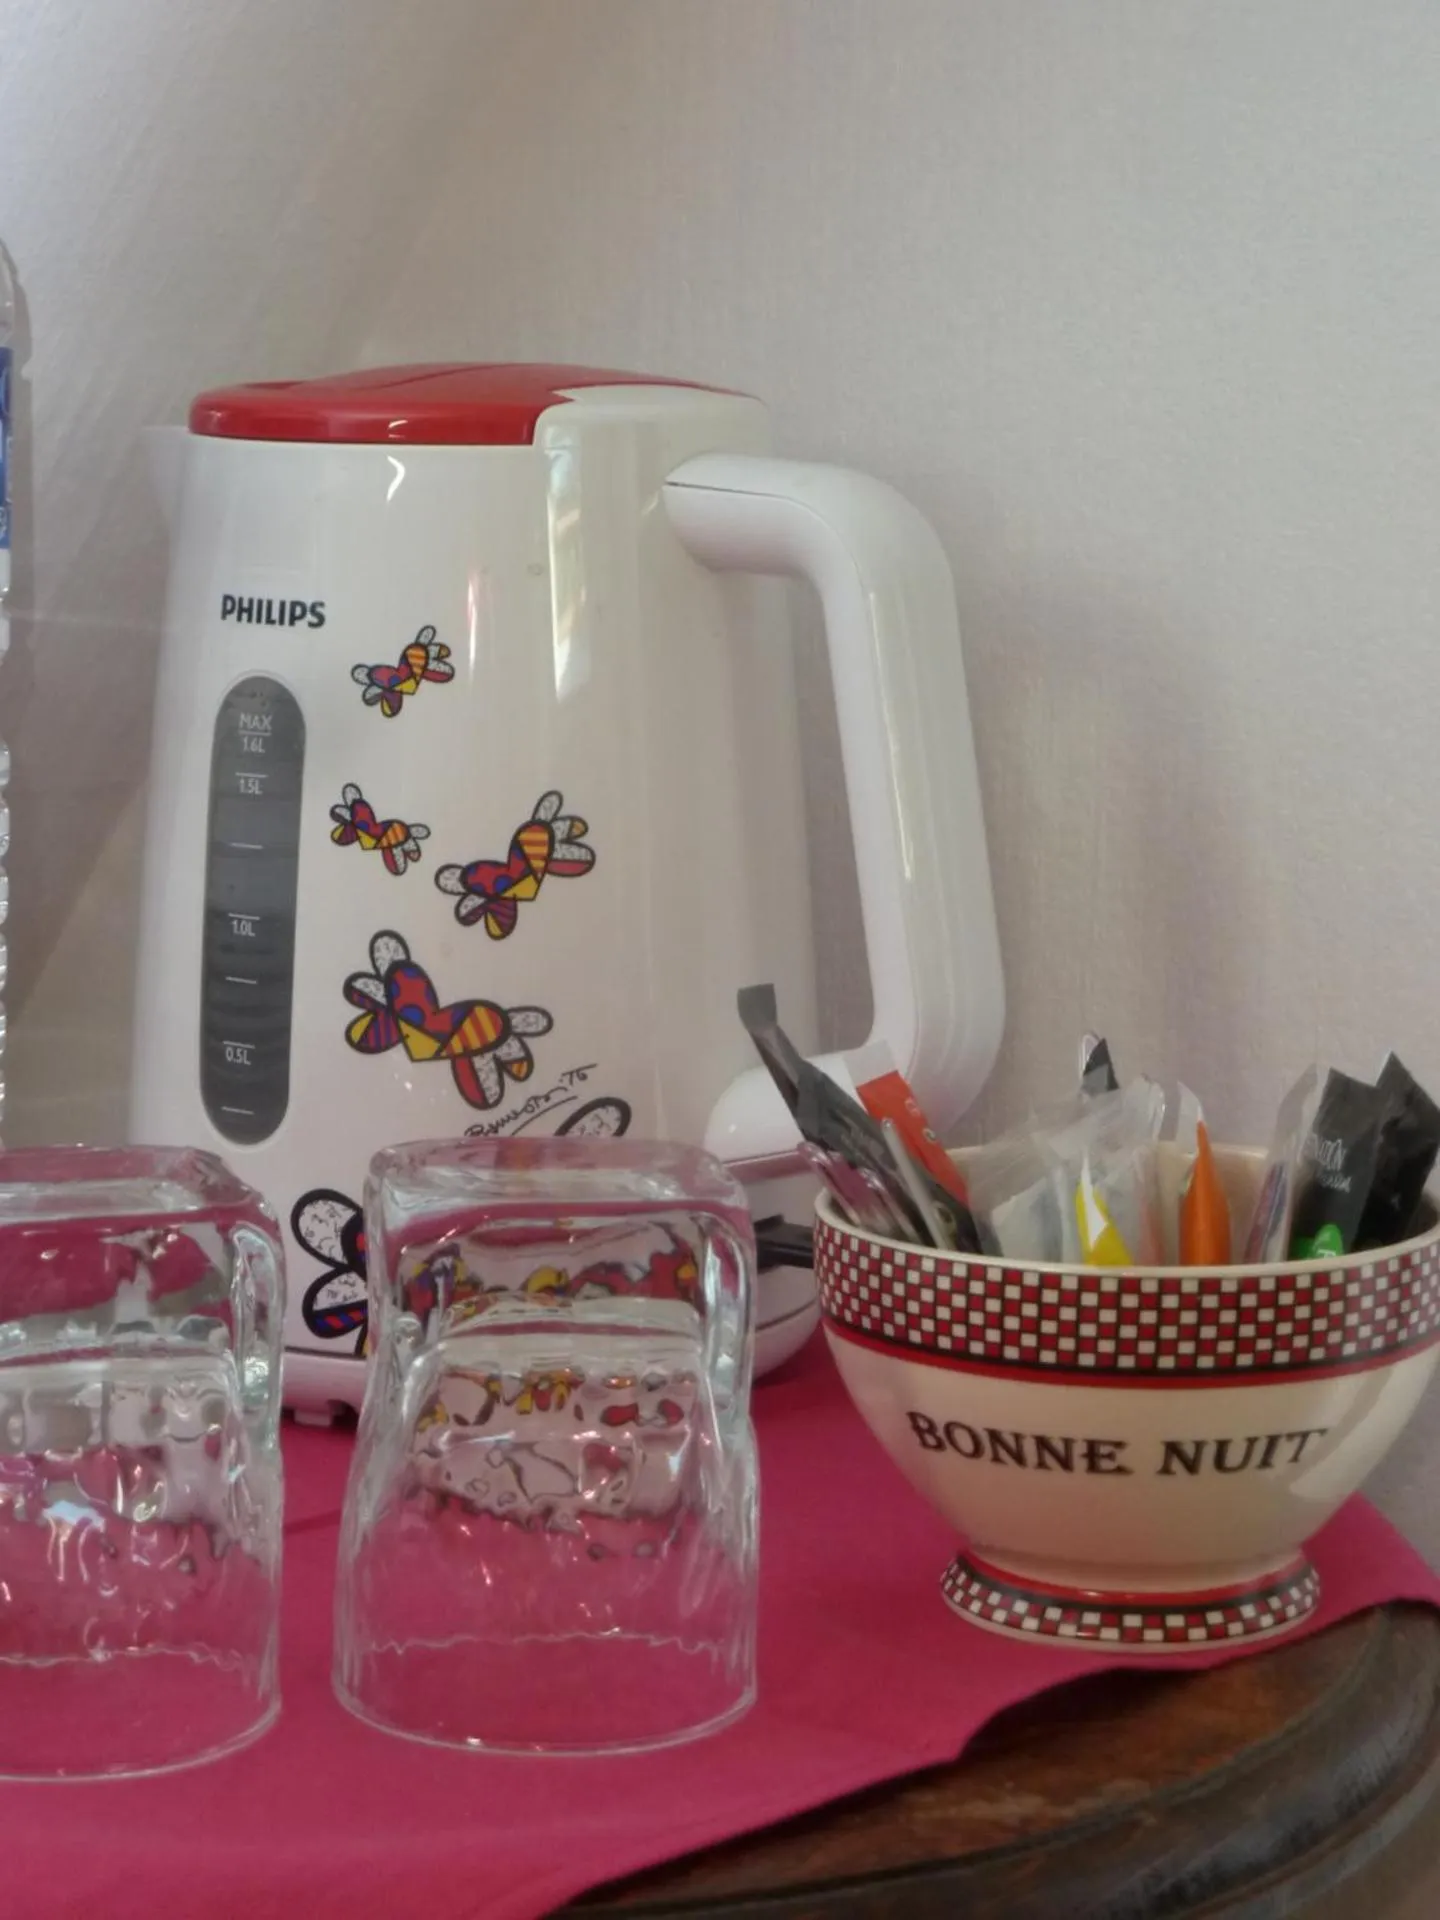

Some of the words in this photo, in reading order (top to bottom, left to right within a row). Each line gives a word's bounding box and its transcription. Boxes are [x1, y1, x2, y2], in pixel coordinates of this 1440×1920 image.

[221, 594, 326, 628] PHILIPS
[239, 712, 273, 730] MAX
[231, 919, 256, 936] 1.0L
[225, 1046, 252, 1065] 0.5L
[906, 1411, 1134, 1476] BONNE
[1156, 1427, 1328, 1476] NUIT
